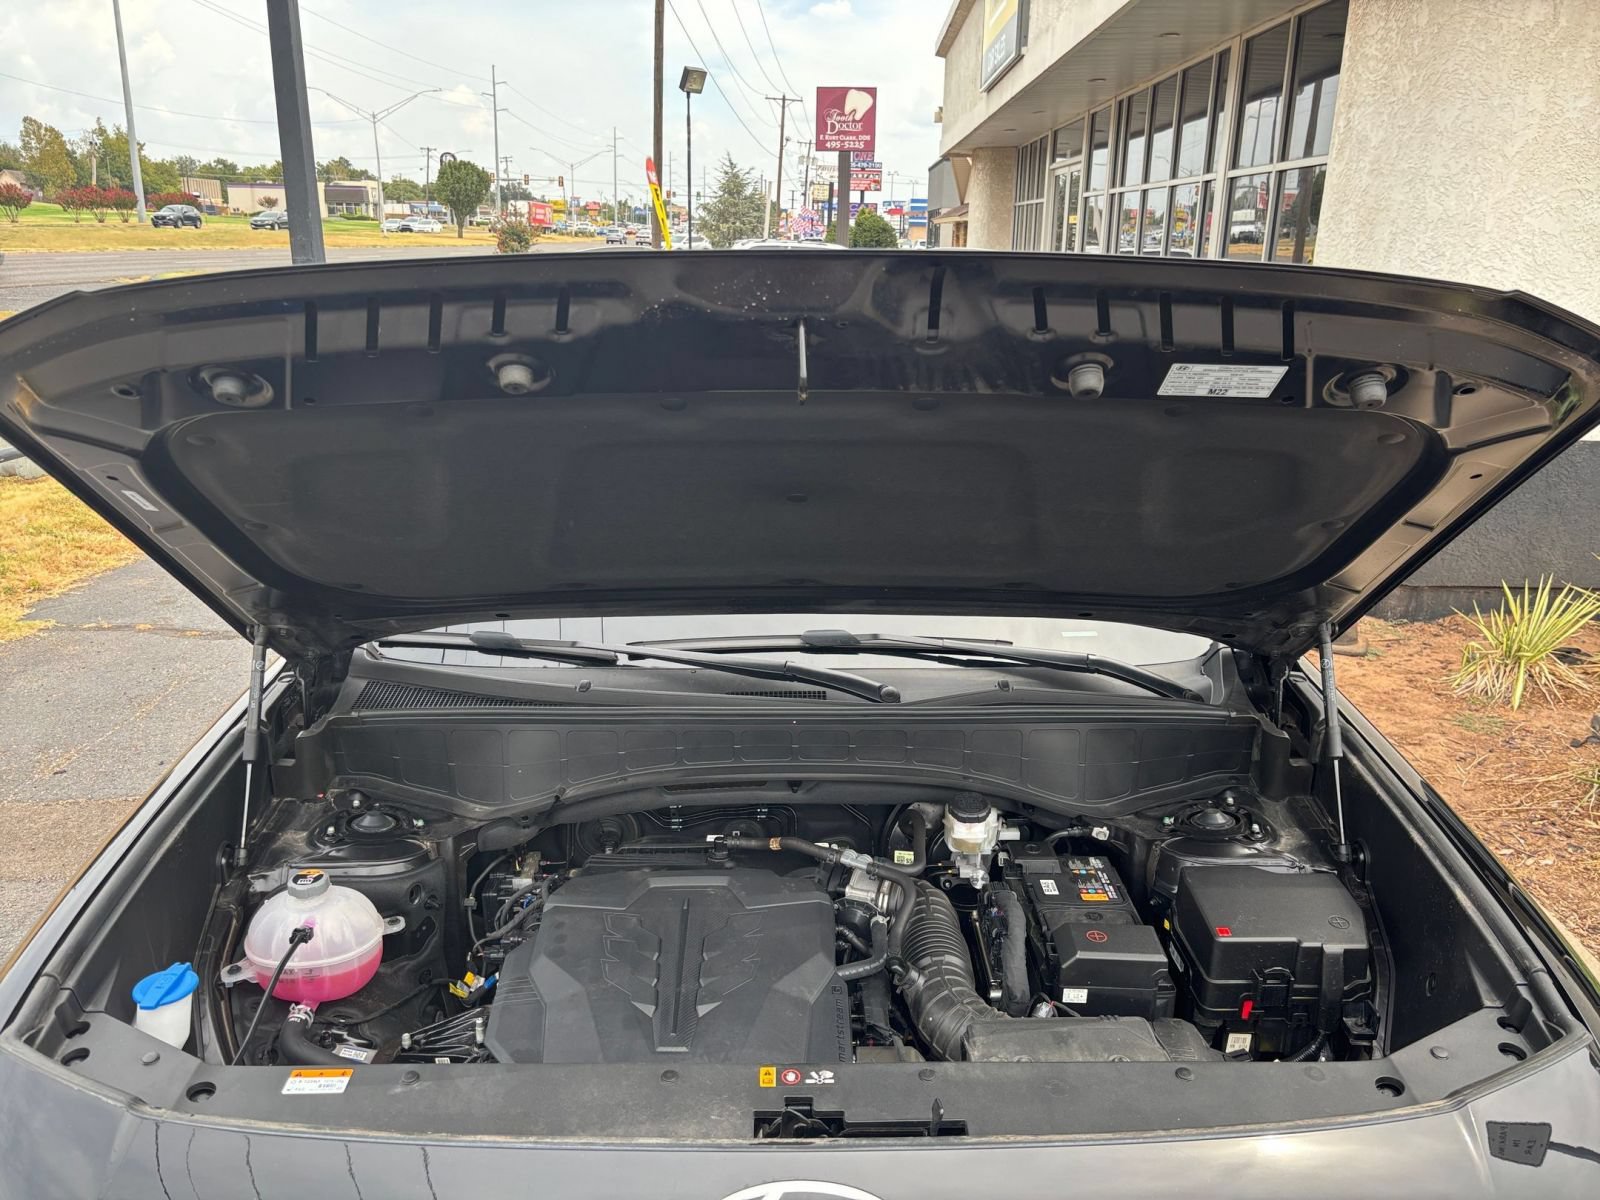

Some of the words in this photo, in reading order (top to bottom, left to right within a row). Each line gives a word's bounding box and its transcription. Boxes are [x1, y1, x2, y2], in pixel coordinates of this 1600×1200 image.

[825, 141, 865, 149] 495-5225
[1207, 388, 1229, 396] M22
[835, 999, 847, 1063] martstream
